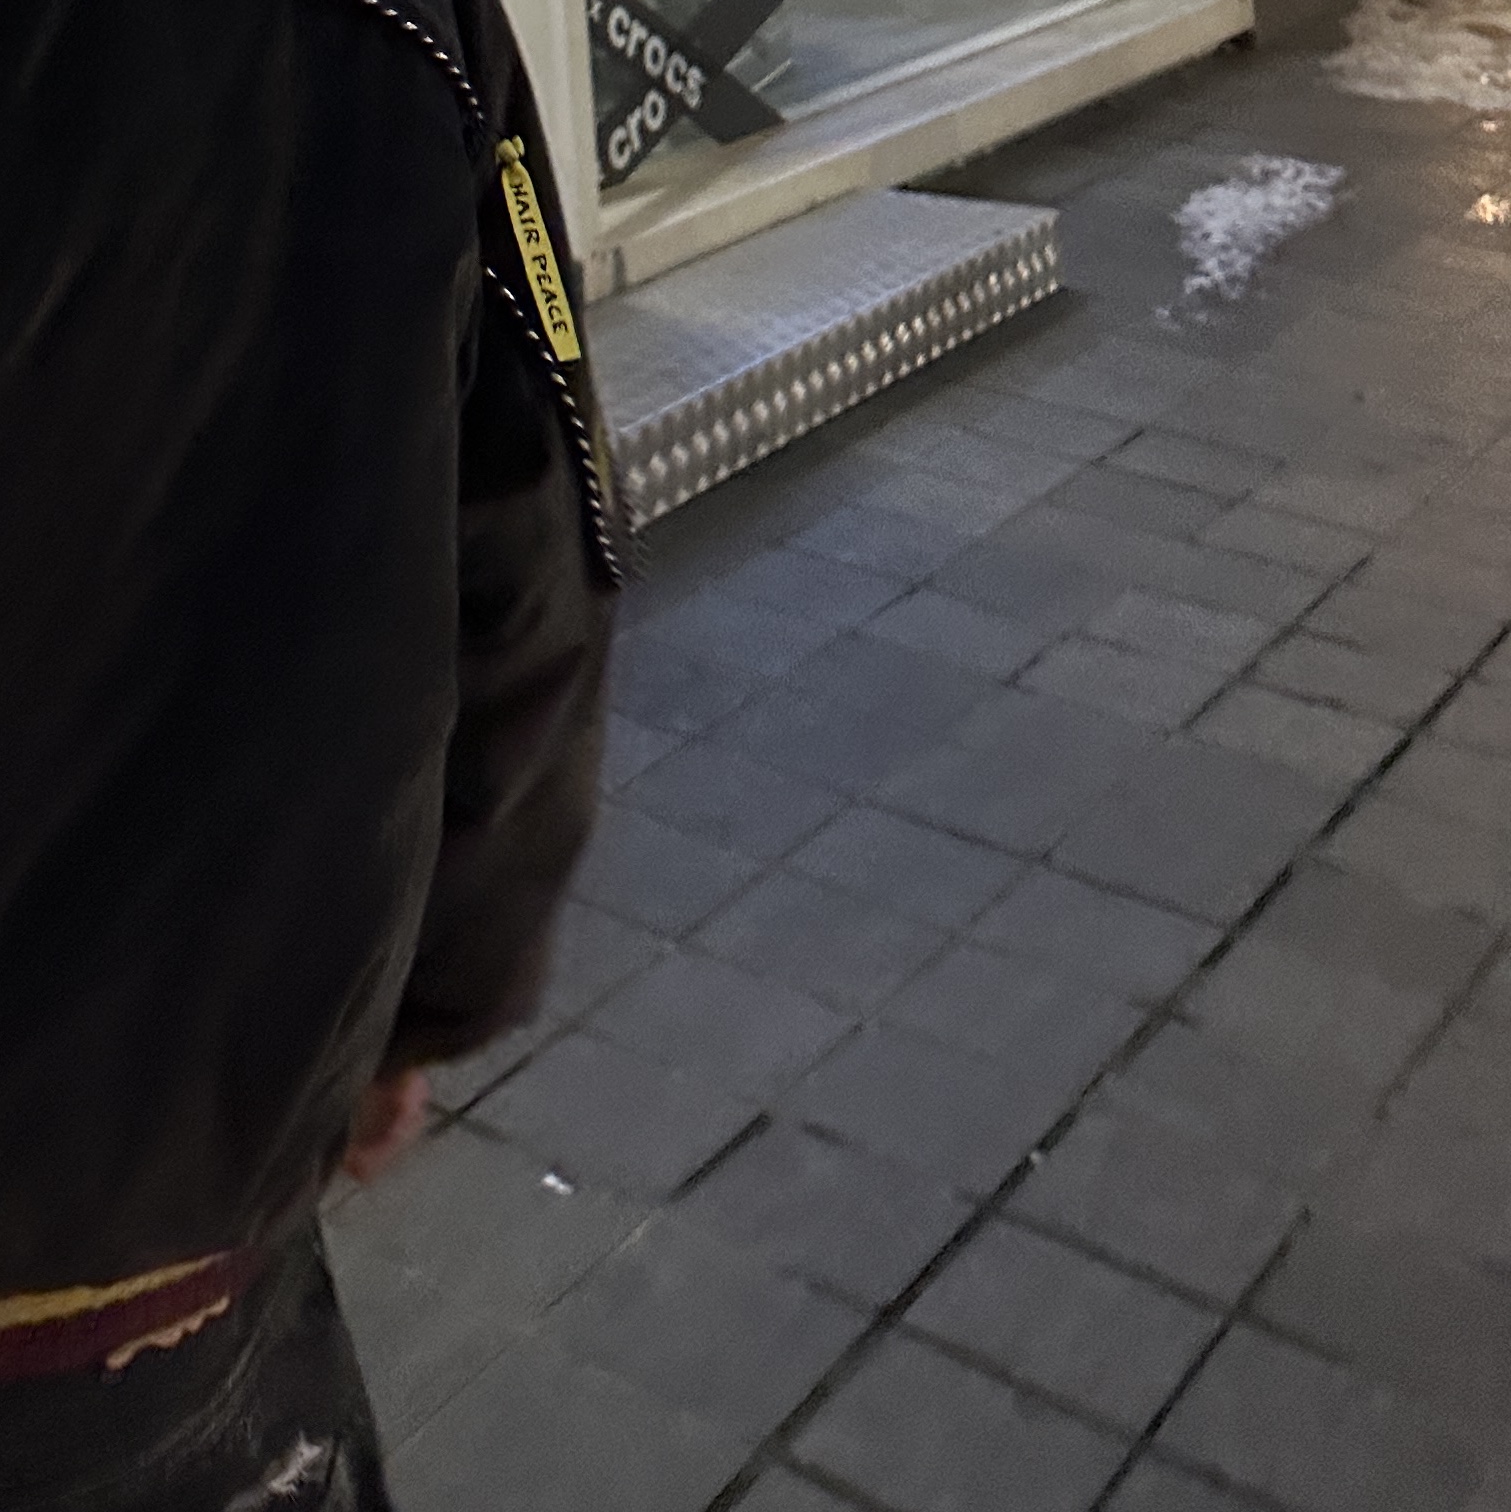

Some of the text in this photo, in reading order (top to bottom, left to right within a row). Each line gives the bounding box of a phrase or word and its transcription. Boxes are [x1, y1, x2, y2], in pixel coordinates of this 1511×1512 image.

[607, 6, 705, 109] crocs
[509, 182, 570, 335] HAIR PEACE
